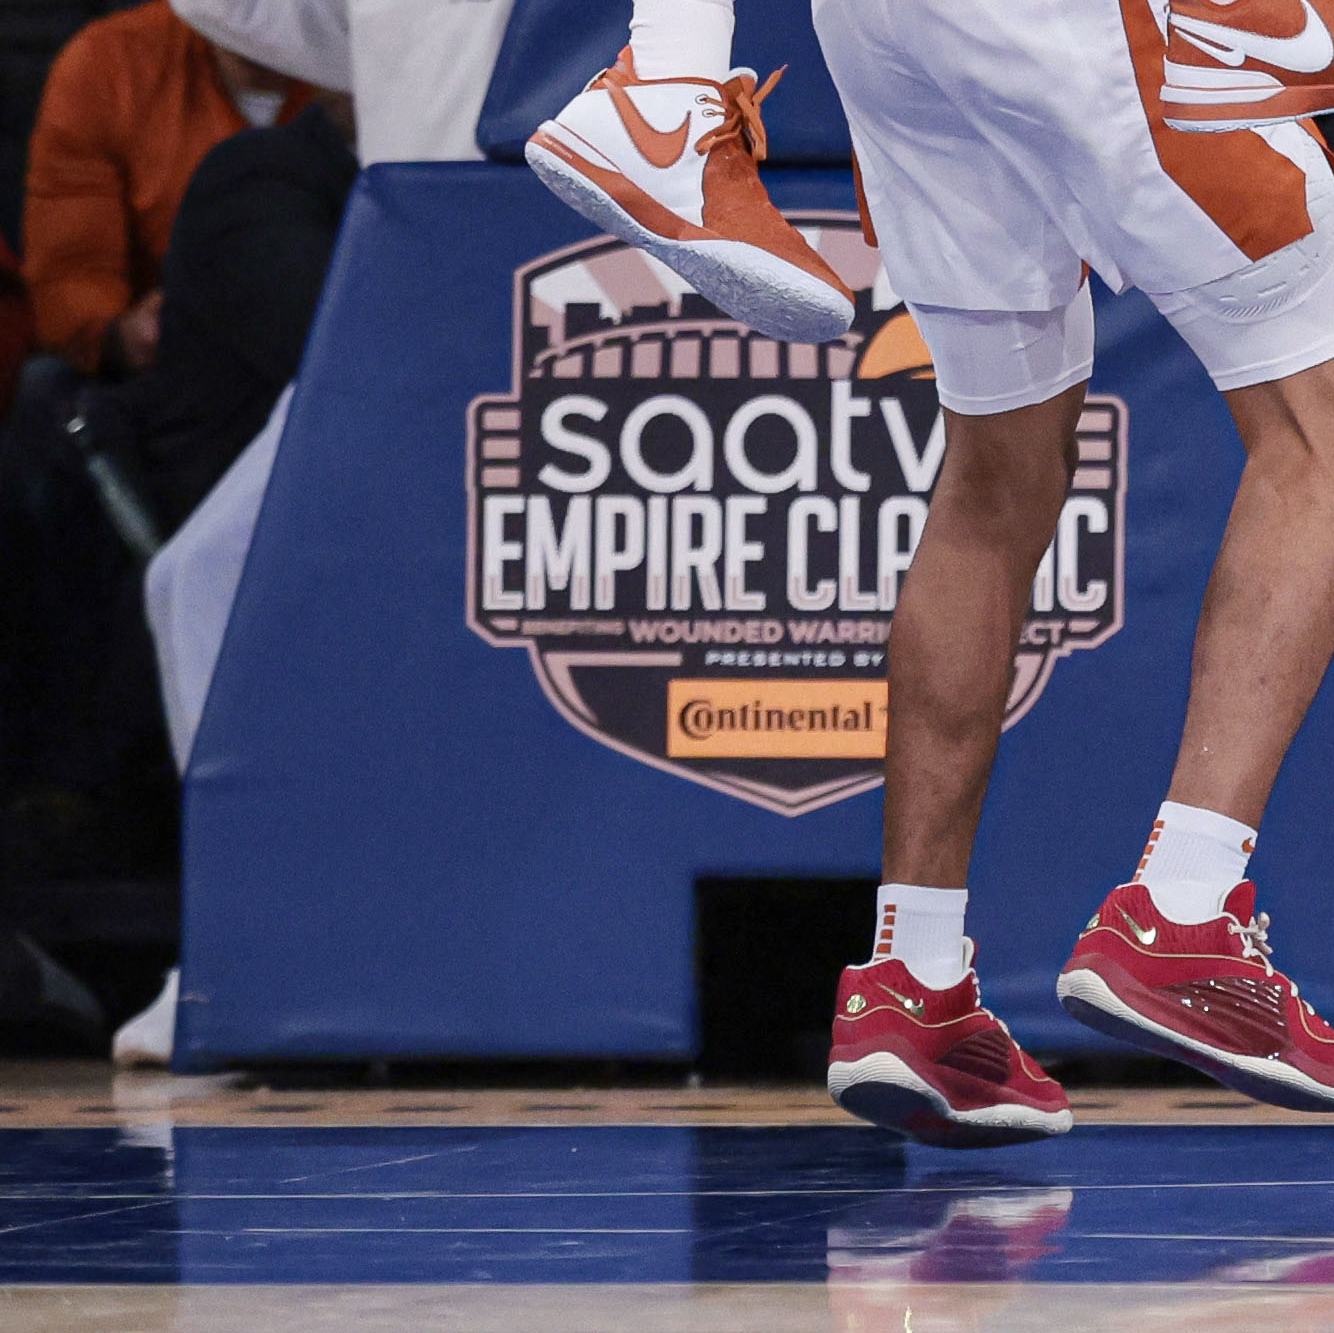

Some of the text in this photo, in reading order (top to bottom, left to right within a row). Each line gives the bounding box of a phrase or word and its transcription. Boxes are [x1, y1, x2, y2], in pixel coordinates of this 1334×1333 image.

[537, 379, 947, 493] saatv
[482, 494, 1109, 612] EMPIRE CLAC
[628, 619, 784, 644] WOUNDED
[787, 619, 891, 644] WARRI
[704, 650, 846, 667] PRESENTED
[679, 700, 873, 740] Continental
